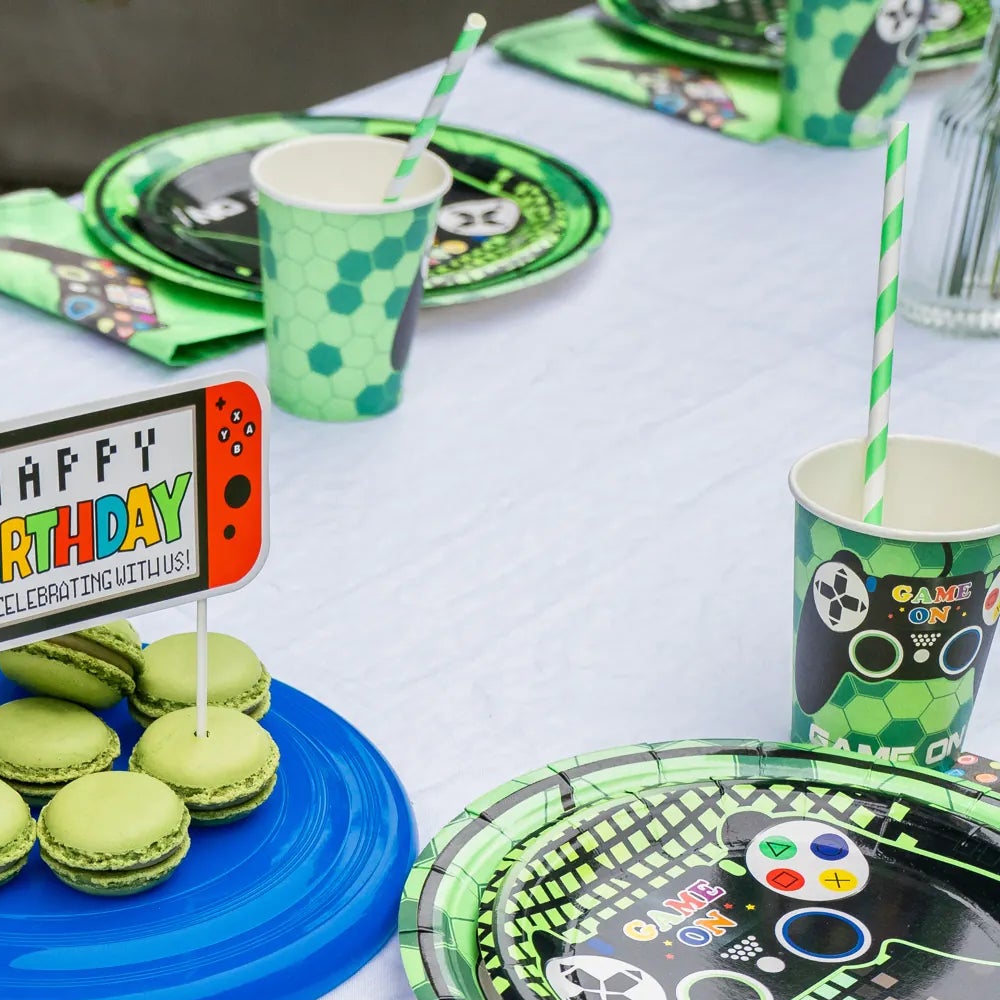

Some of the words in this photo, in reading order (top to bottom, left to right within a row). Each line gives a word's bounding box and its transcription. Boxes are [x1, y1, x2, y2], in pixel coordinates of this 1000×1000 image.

[232, 410, 241, 422] X
[220, 429, 229, 440] Y
[245, 424, 254, 435] A
[233, 443, 241, 454] B
[116, 557, 160, 587] WITH
[163, 549, 190, 575] US!
[891, 581, 973, 604] GAME
[908, 605, 952, 625] ON
[925, 724, 967, 765] ON
[623, 879, 727, 941] GAME
[676, 909, 738, 947] ON
